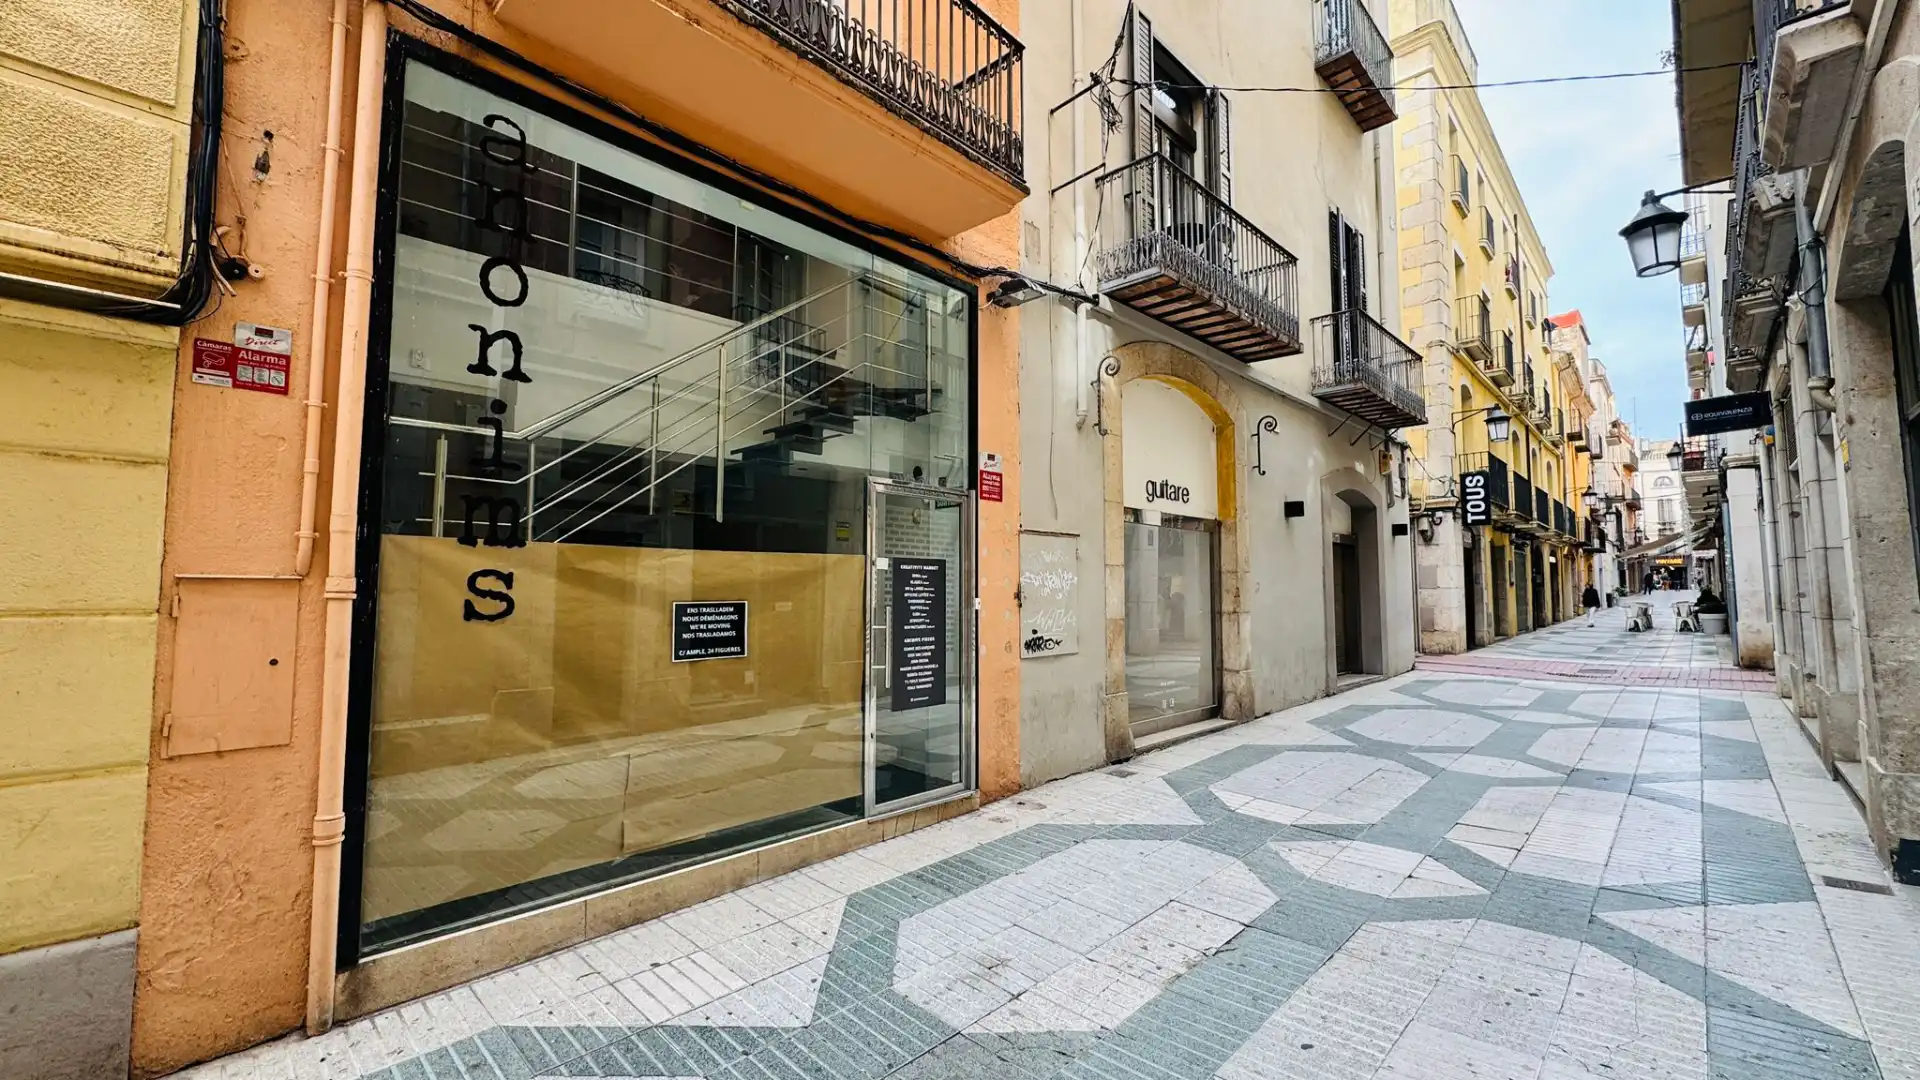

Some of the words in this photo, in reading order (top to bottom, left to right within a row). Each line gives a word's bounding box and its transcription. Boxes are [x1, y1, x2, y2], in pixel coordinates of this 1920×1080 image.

[238, 350, 287, 366] Alarma
[457, 114, 540, 622] anonims
[1145, 479, 1190, 504] guitare
[1465, 475, 1486, 524] TOUS
[696, 630, 736, 638] TRASLADAMOS
[715, 646, 741, 654] FIGUERES
